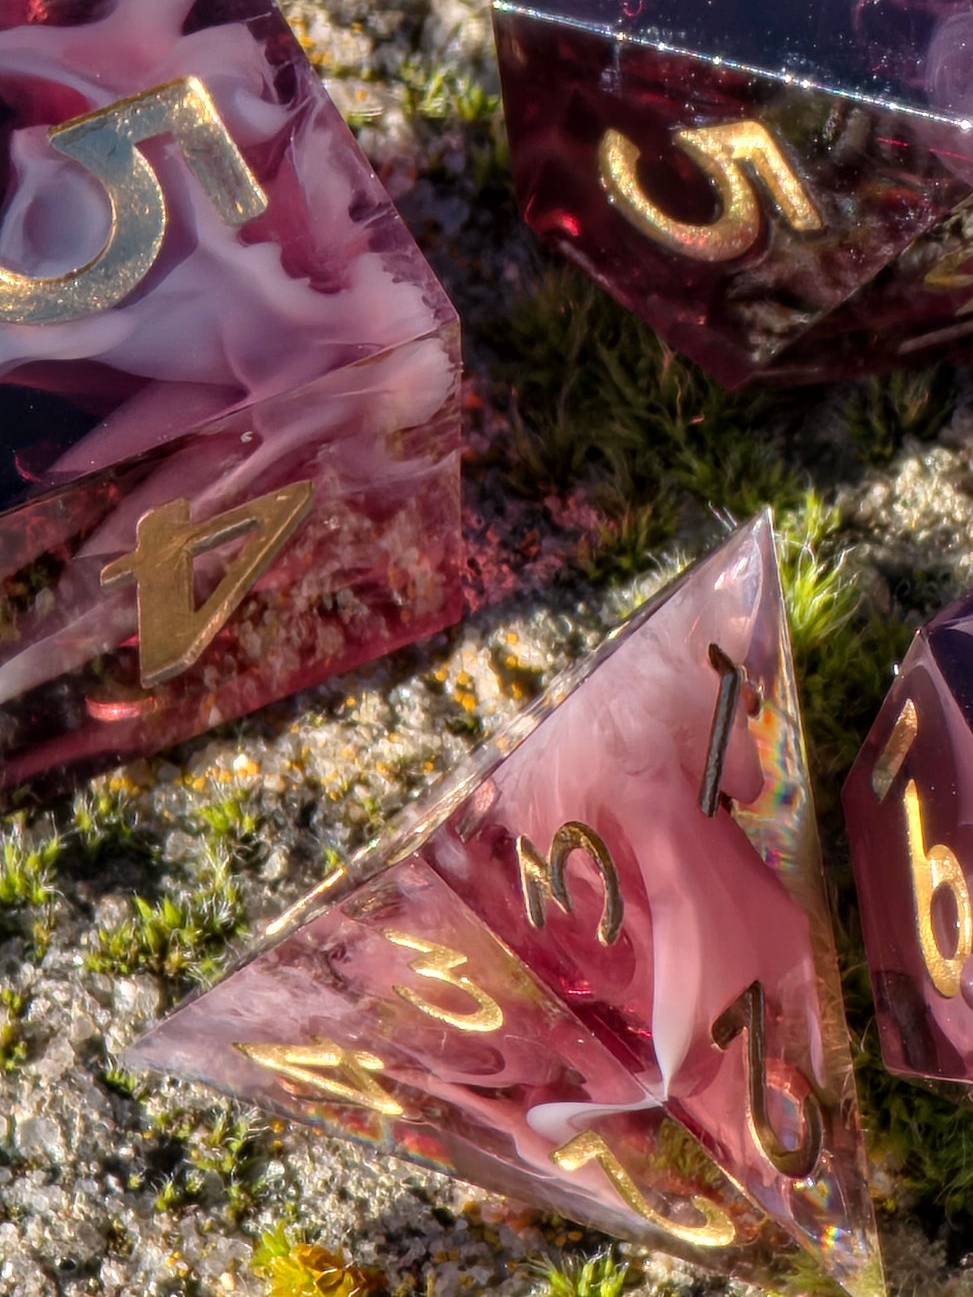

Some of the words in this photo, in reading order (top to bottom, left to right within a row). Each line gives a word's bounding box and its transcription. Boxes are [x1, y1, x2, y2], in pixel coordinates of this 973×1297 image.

[601, 120, 823, 262] 5
[515, 821, 624, 946] 3
[382, 928, 504, 1033] 3
